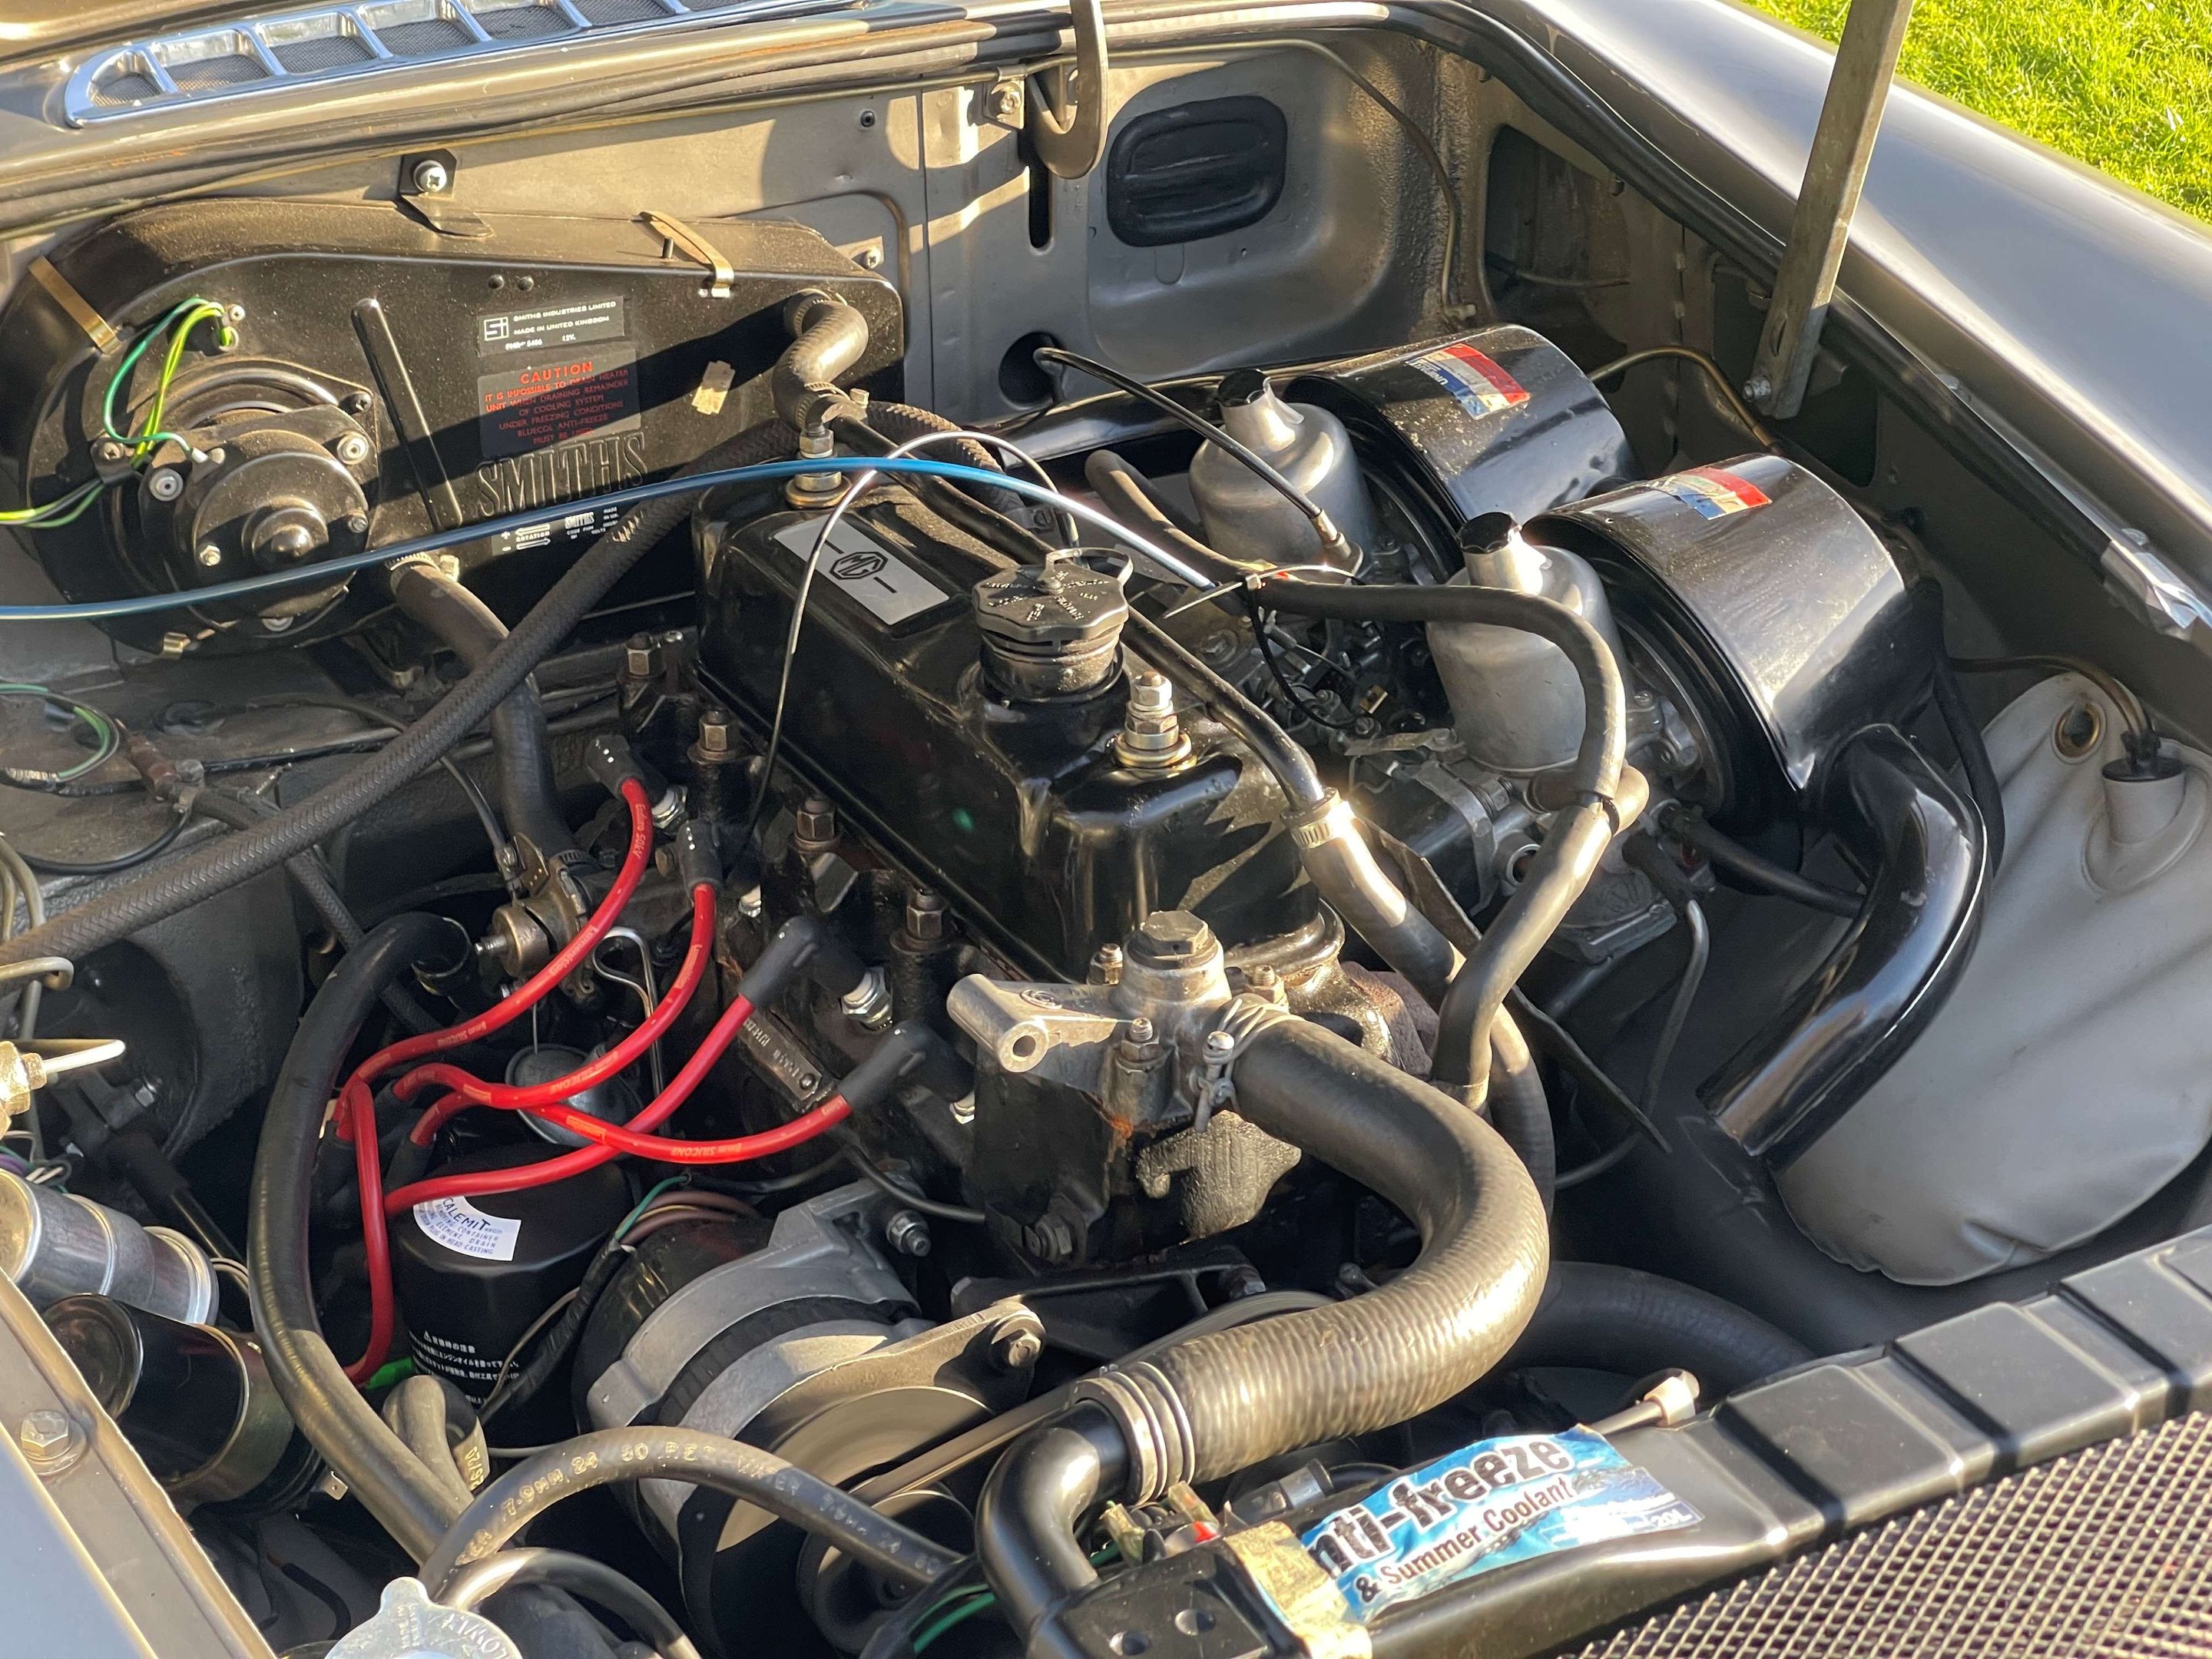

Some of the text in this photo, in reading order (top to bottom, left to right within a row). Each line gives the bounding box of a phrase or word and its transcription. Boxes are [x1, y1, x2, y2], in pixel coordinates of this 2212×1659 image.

[513, 301, 616, 322] SMITHS INDUSTRIES LIMITED
[514, 326, 535, 335] MADE
[546, 321, 574, 330] UNITED
[575, 316, 610, 326] KINGDOM
[507, 384, 551, 398] IMPOSSIBLE
[595, 369, 629, 381] HEATER
[520, 361, 593, 384] CAUTION
[485, 402, 507, 413] UNIT
[540, 389, 581, 402] DRAINING
[584, 379, 628, 394] REMAINDER
[519, 394, 604, 417] OF COOLING SYSTEM
[499, 401, 624, 431] UNDER FREEZING CONDITIONS
[518, 425, 553, 437] BLUECOL
[475, 431, 648, 518] SMITHS
[565, 512, 594, 529] SMITHS
[516, 531, 551, 542] ROTATION
[833, 553, 886, 578] MG
[457, 1227, 498, 1241] CONTAINER
[469, 1237, 496, 1248] DRAIN
[465, 1244, 493, 1254] CASTING
[571, 1452, 598, 1475] 24
[1353, 1575, 1382, 1603] &
[1379, 1523, 1483, 1585] Summer
[1482, 1475, 1577, 1534] Coolant
